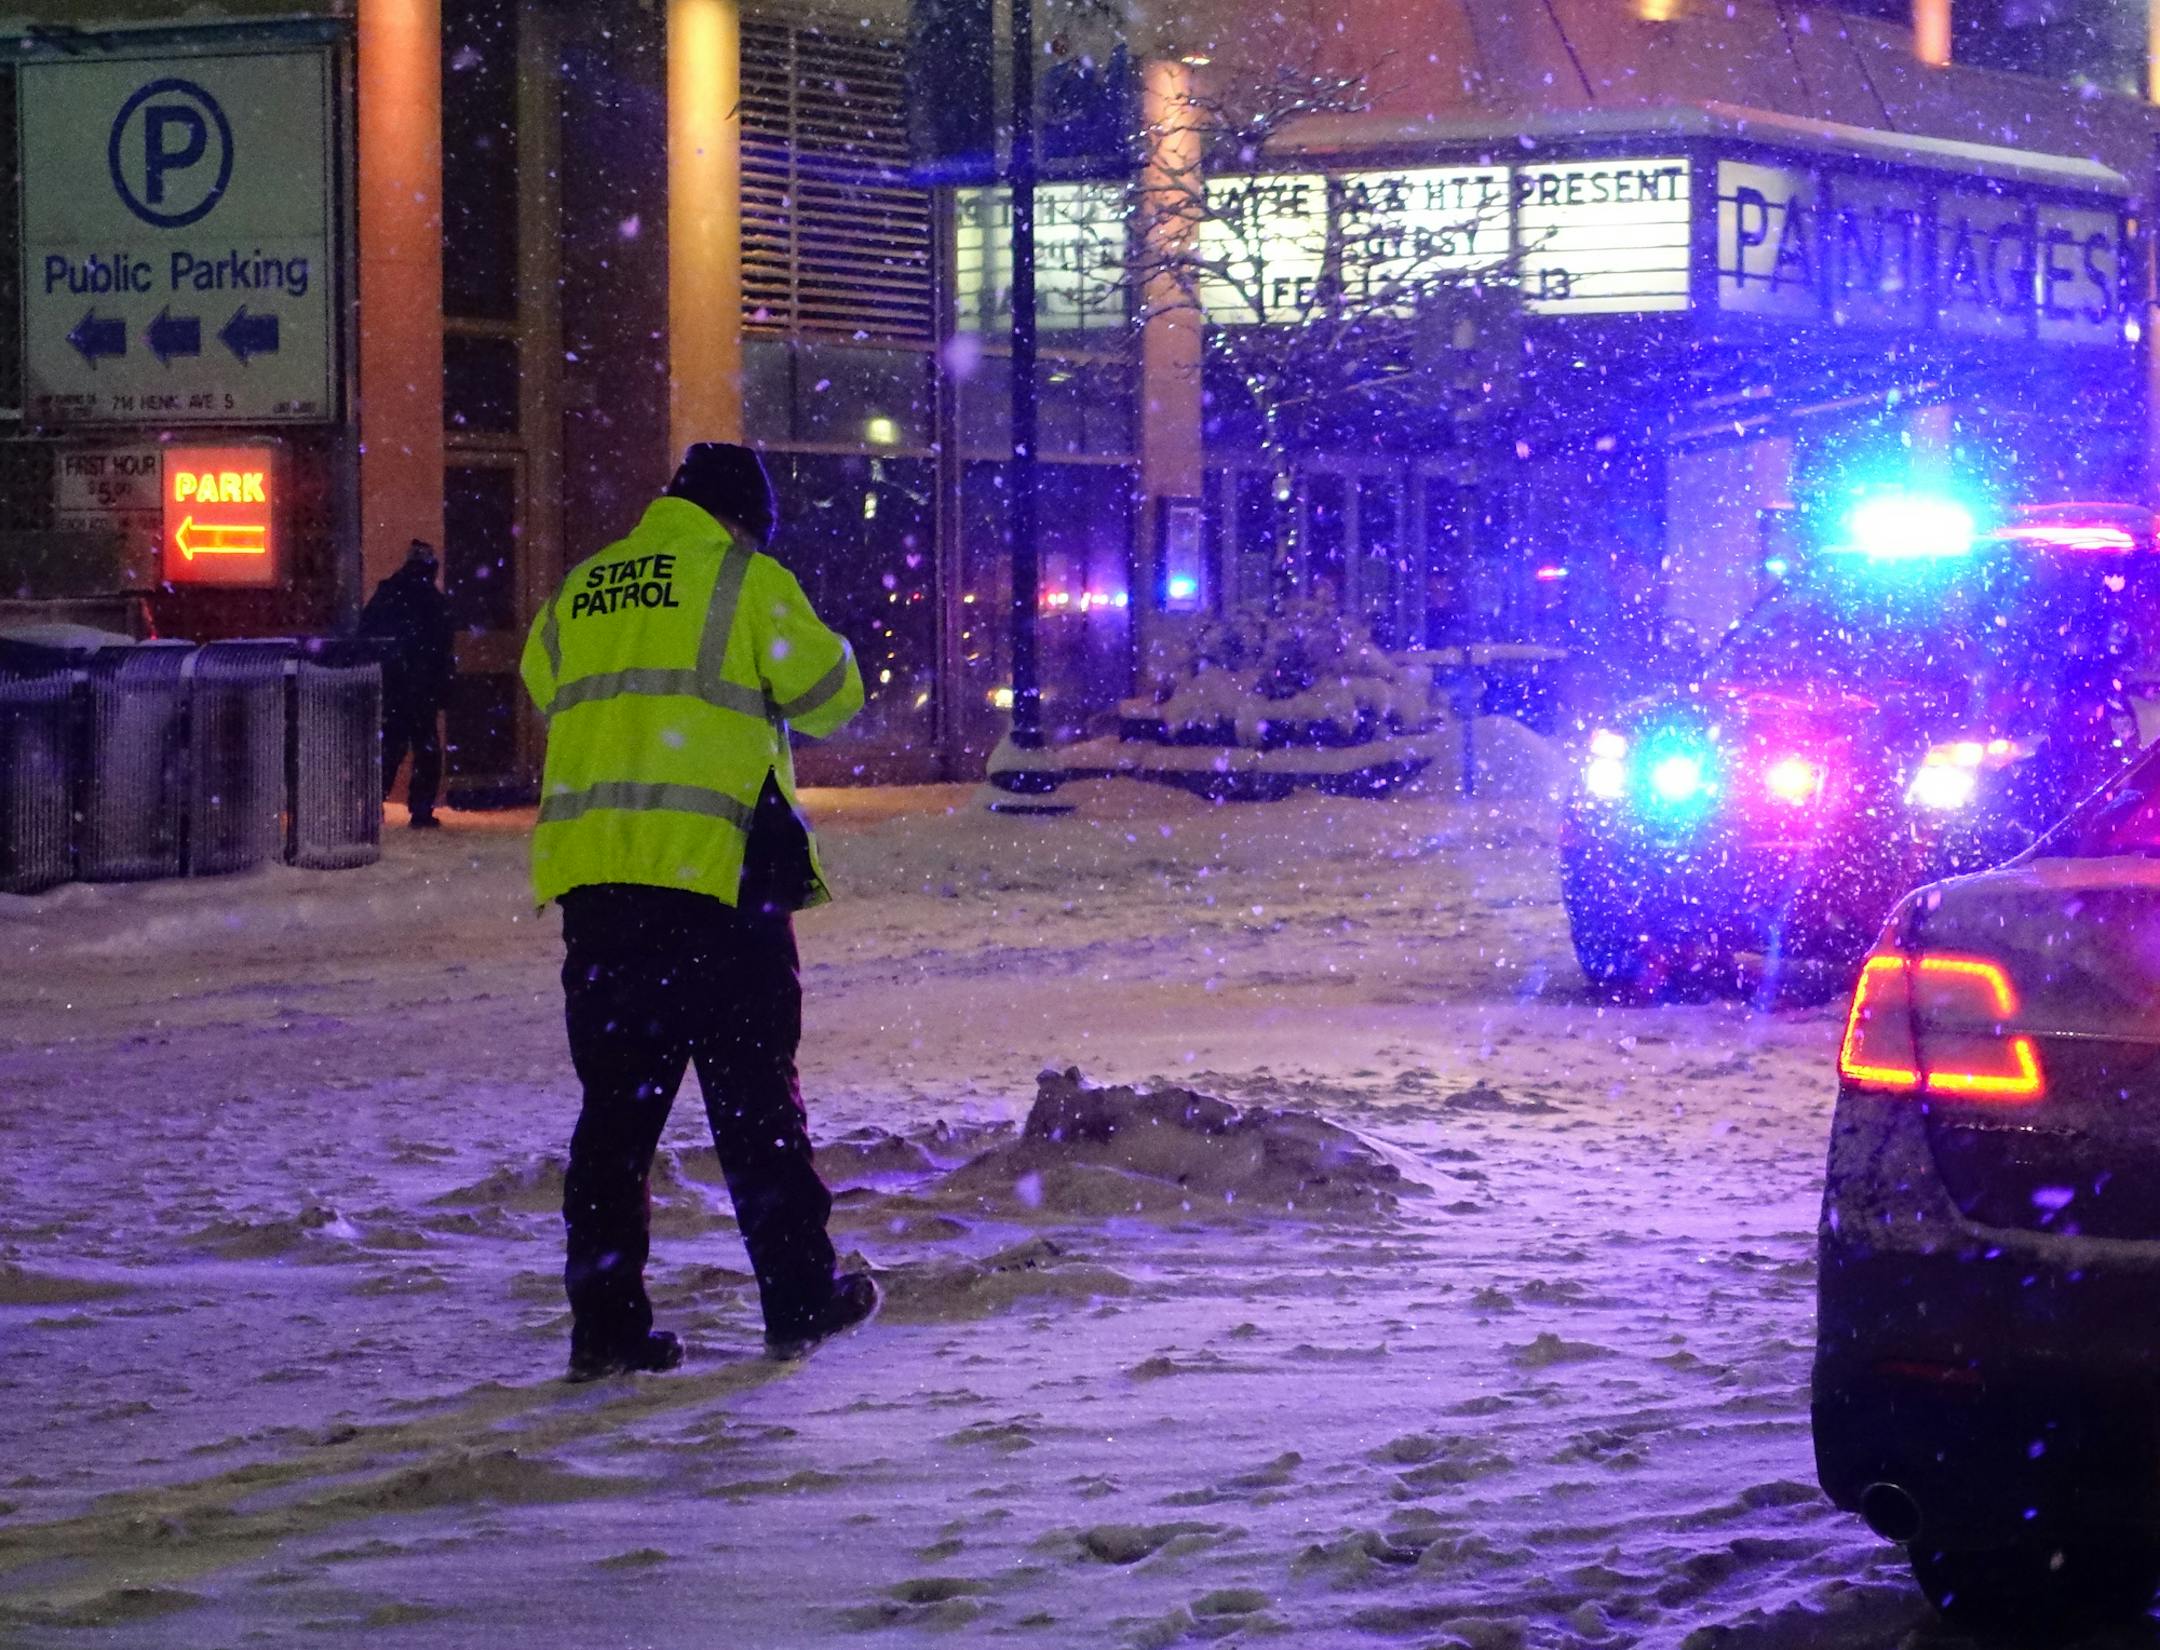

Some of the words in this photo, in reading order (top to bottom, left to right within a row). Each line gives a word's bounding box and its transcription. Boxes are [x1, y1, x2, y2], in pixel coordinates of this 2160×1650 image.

[1514, 166, 1683, 206] PRESENT
[45, 254, 152, 294] Public
[170, 249, 309, 297] Parking
[1735, 184, 2117, 323] PANTAGES
[112, 455, 156, 476] HOUR
[174, 471, 266, 503] PARK
[586, 553, 677, 589] STATE
[571, 581, 680, 620] PATROL
